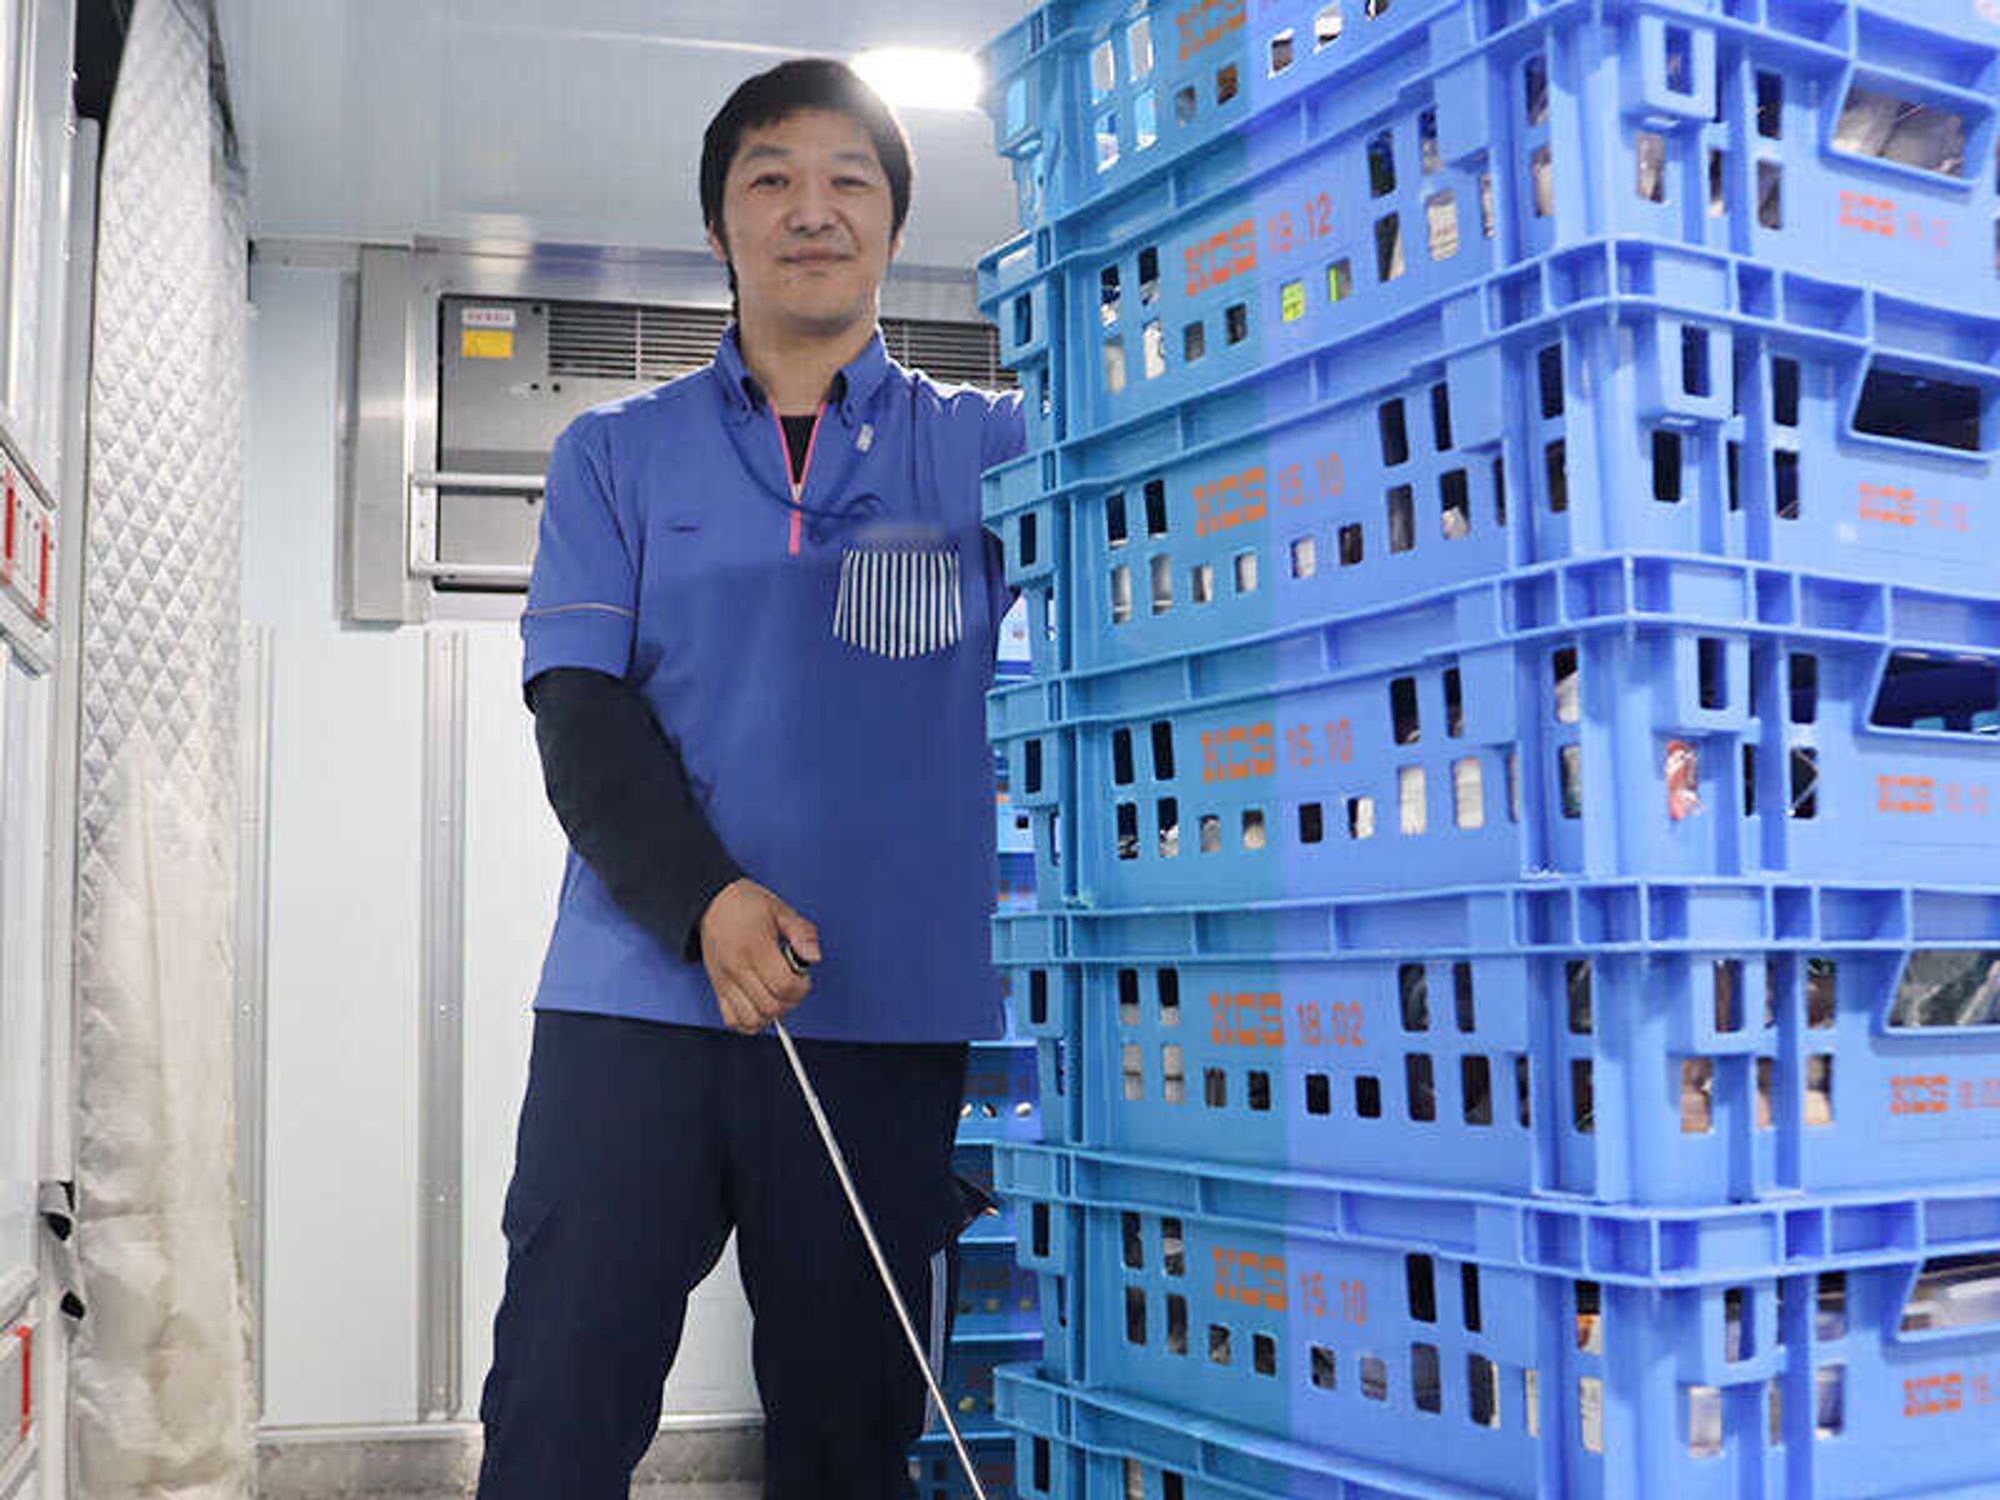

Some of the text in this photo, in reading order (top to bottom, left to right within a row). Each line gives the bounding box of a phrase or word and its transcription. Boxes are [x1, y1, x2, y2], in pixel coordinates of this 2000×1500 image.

[1183, 218, 1256, 297] KCS
[1193, 466, 1267, 538] KCS
[1201, 722, 1274, 784] KCS
[1208, 992, 1365, 1048] KCS 18.02
[1212, 1246, 1288, 1312] KCS
